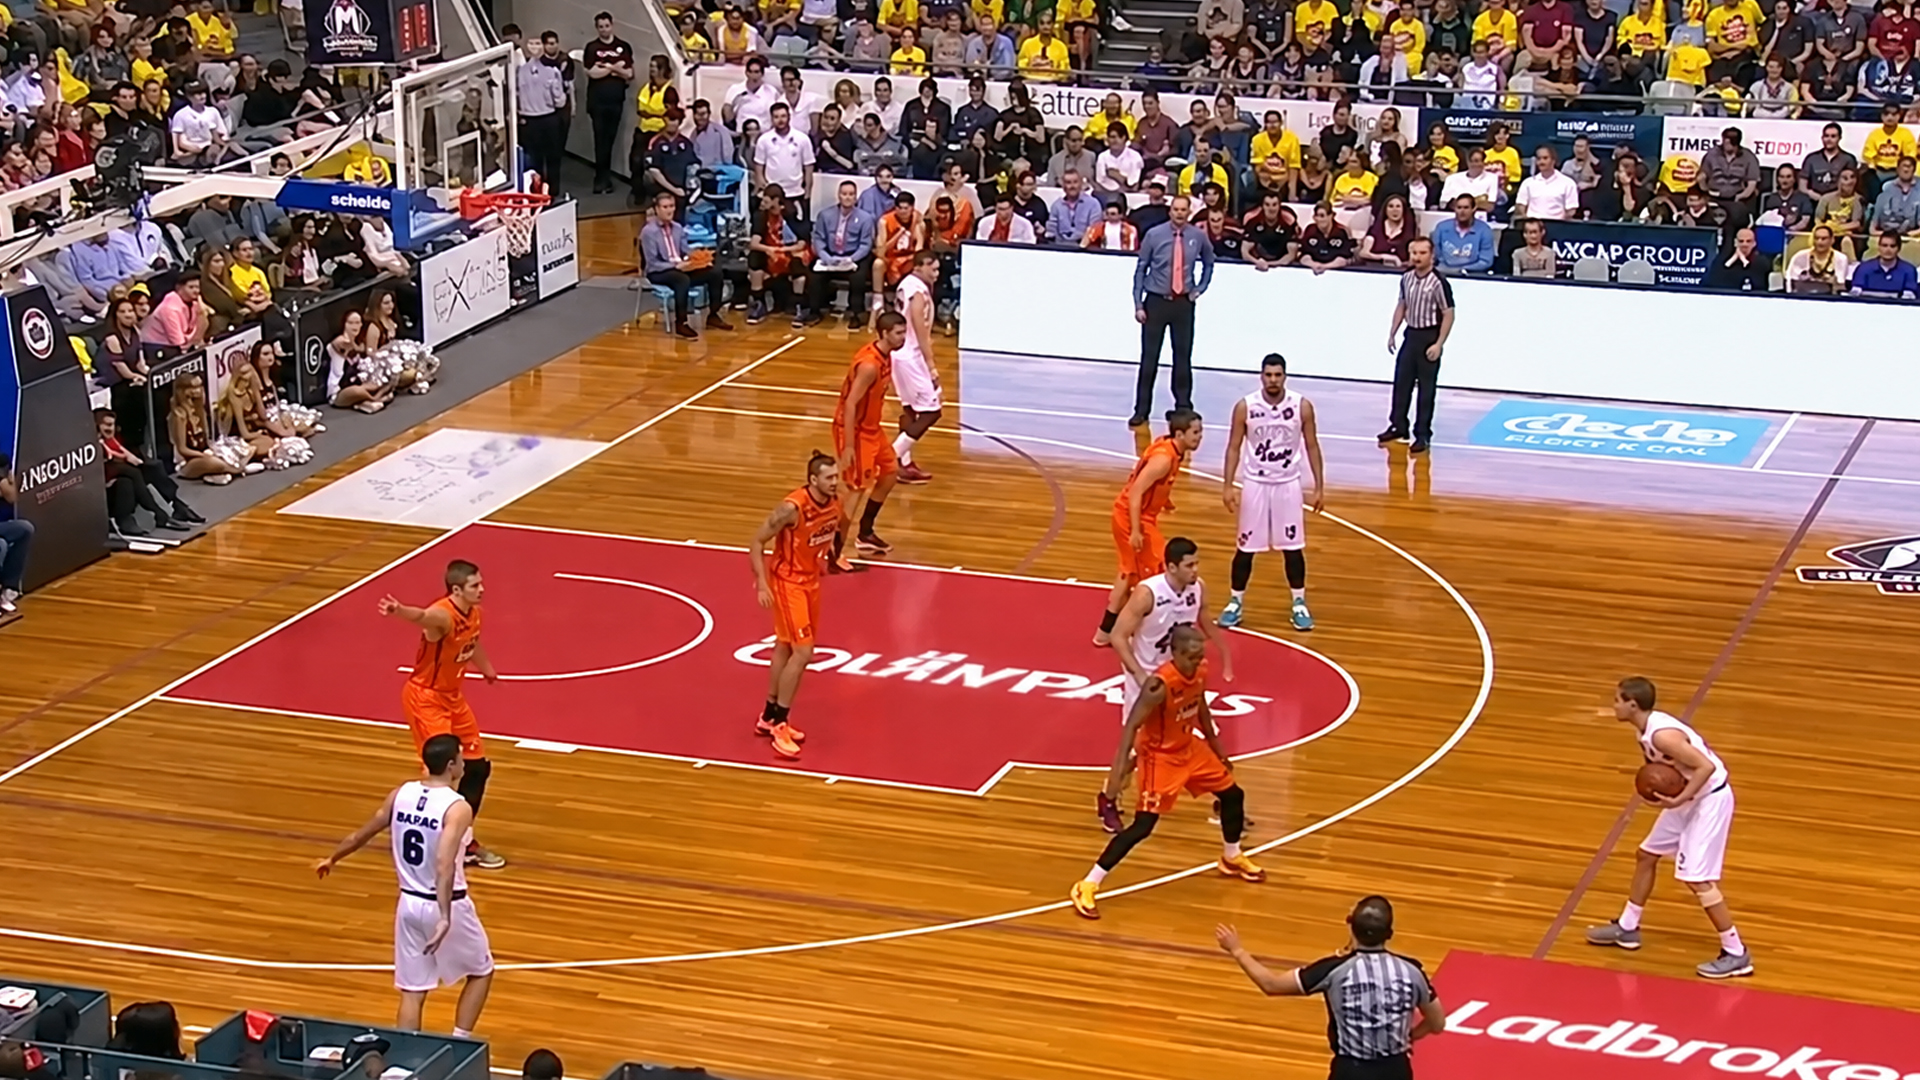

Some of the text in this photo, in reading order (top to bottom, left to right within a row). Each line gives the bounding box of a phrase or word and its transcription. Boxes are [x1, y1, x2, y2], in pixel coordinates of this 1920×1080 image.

[331, 193, 391, 210] schelde
[1625, 244, 1706, 266] GROUP
[403, 829, 425, 866] 6
